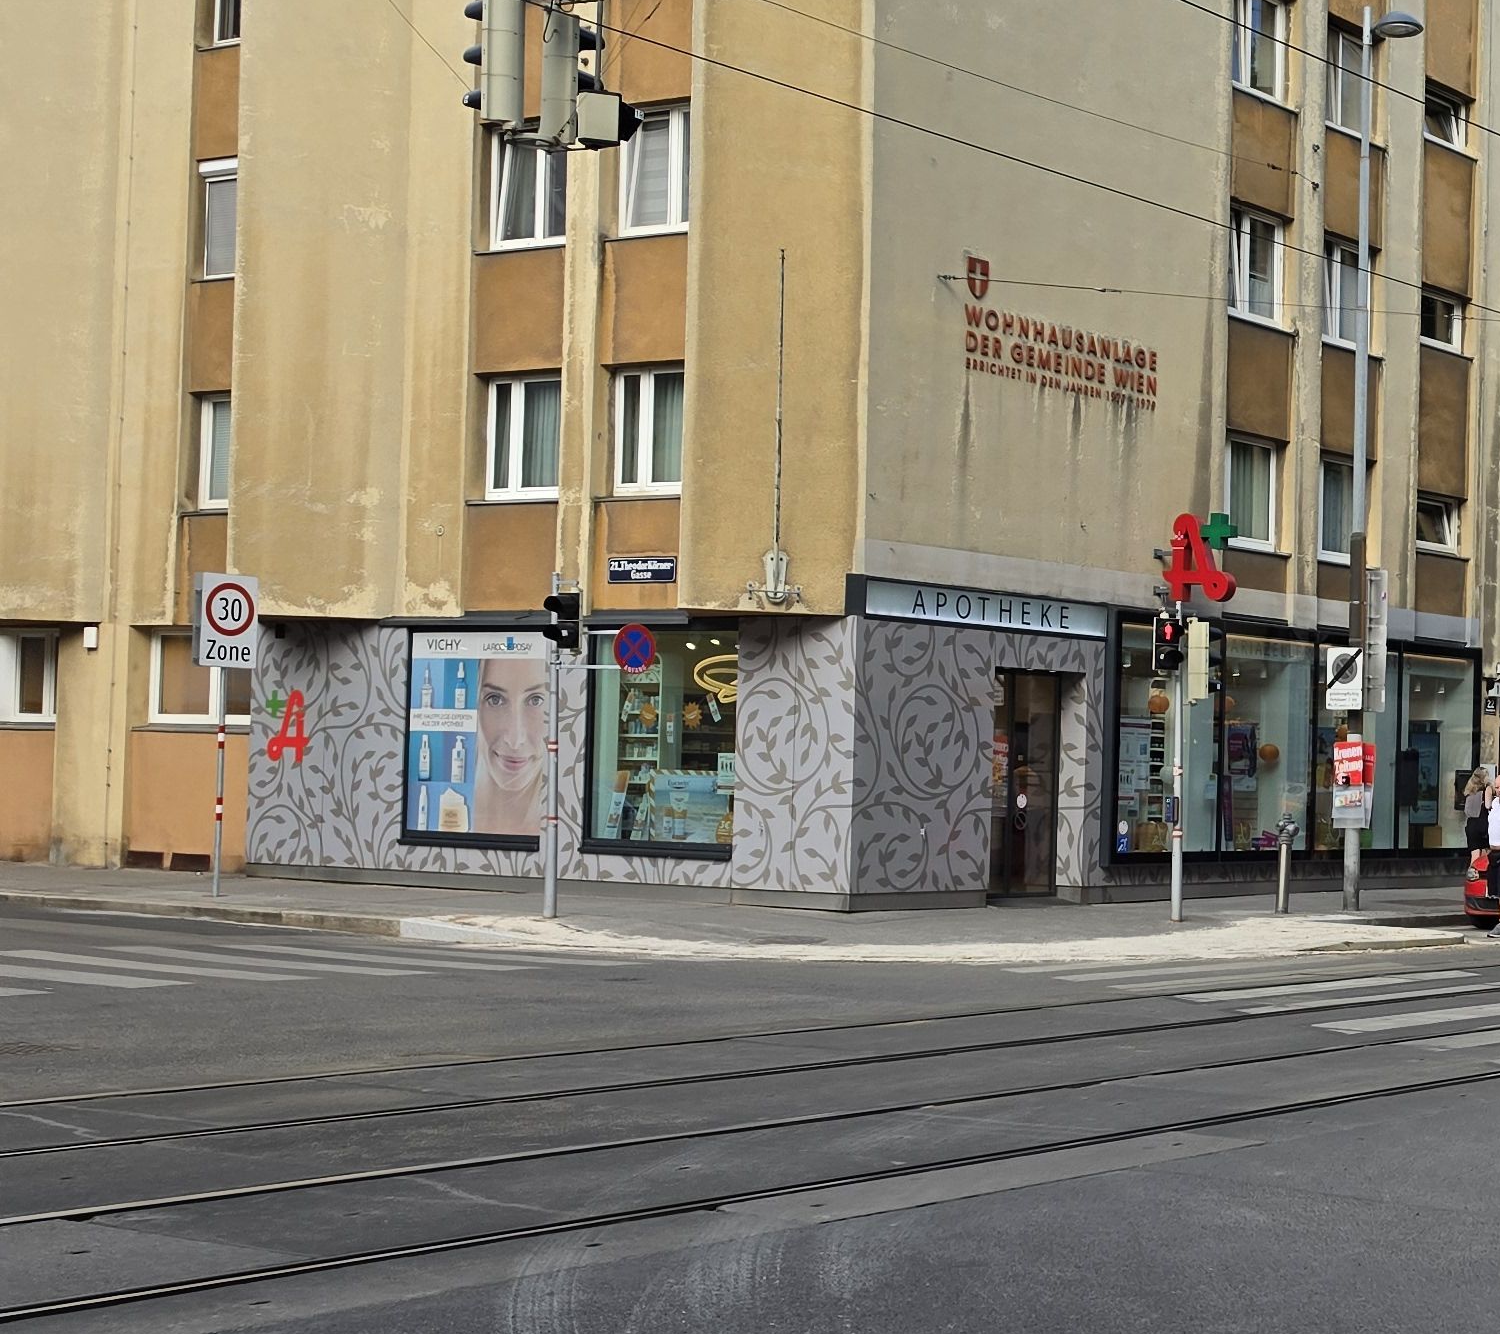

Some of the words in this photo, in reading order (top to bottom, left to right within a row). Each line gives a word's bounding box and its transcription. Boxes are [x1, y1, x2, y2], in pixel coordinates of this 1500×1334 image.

[965, 304, 1158, 372] WOHNHAUSANLAGE
[966, 330, 1002, 359] DER
[1011, 342, 1106, 384] GEMEINDE
[1113, 366, 1157, 397] WIEN
[966, 357, 1021, 381] ERRICHTET
[1026, 371, 1036, 384] IN
[1041, 375, 1061, 390] DEN
[1065, 380, 1101, 399] JAHREN
[630, 570, 652, 579] Gasse
[218, 597, 242, 622] 30
[912, 589, 1070, 629] APOTHEKE
[205, 639, 251, 662] Zone
[426, 639, 462, 651] VICHY
